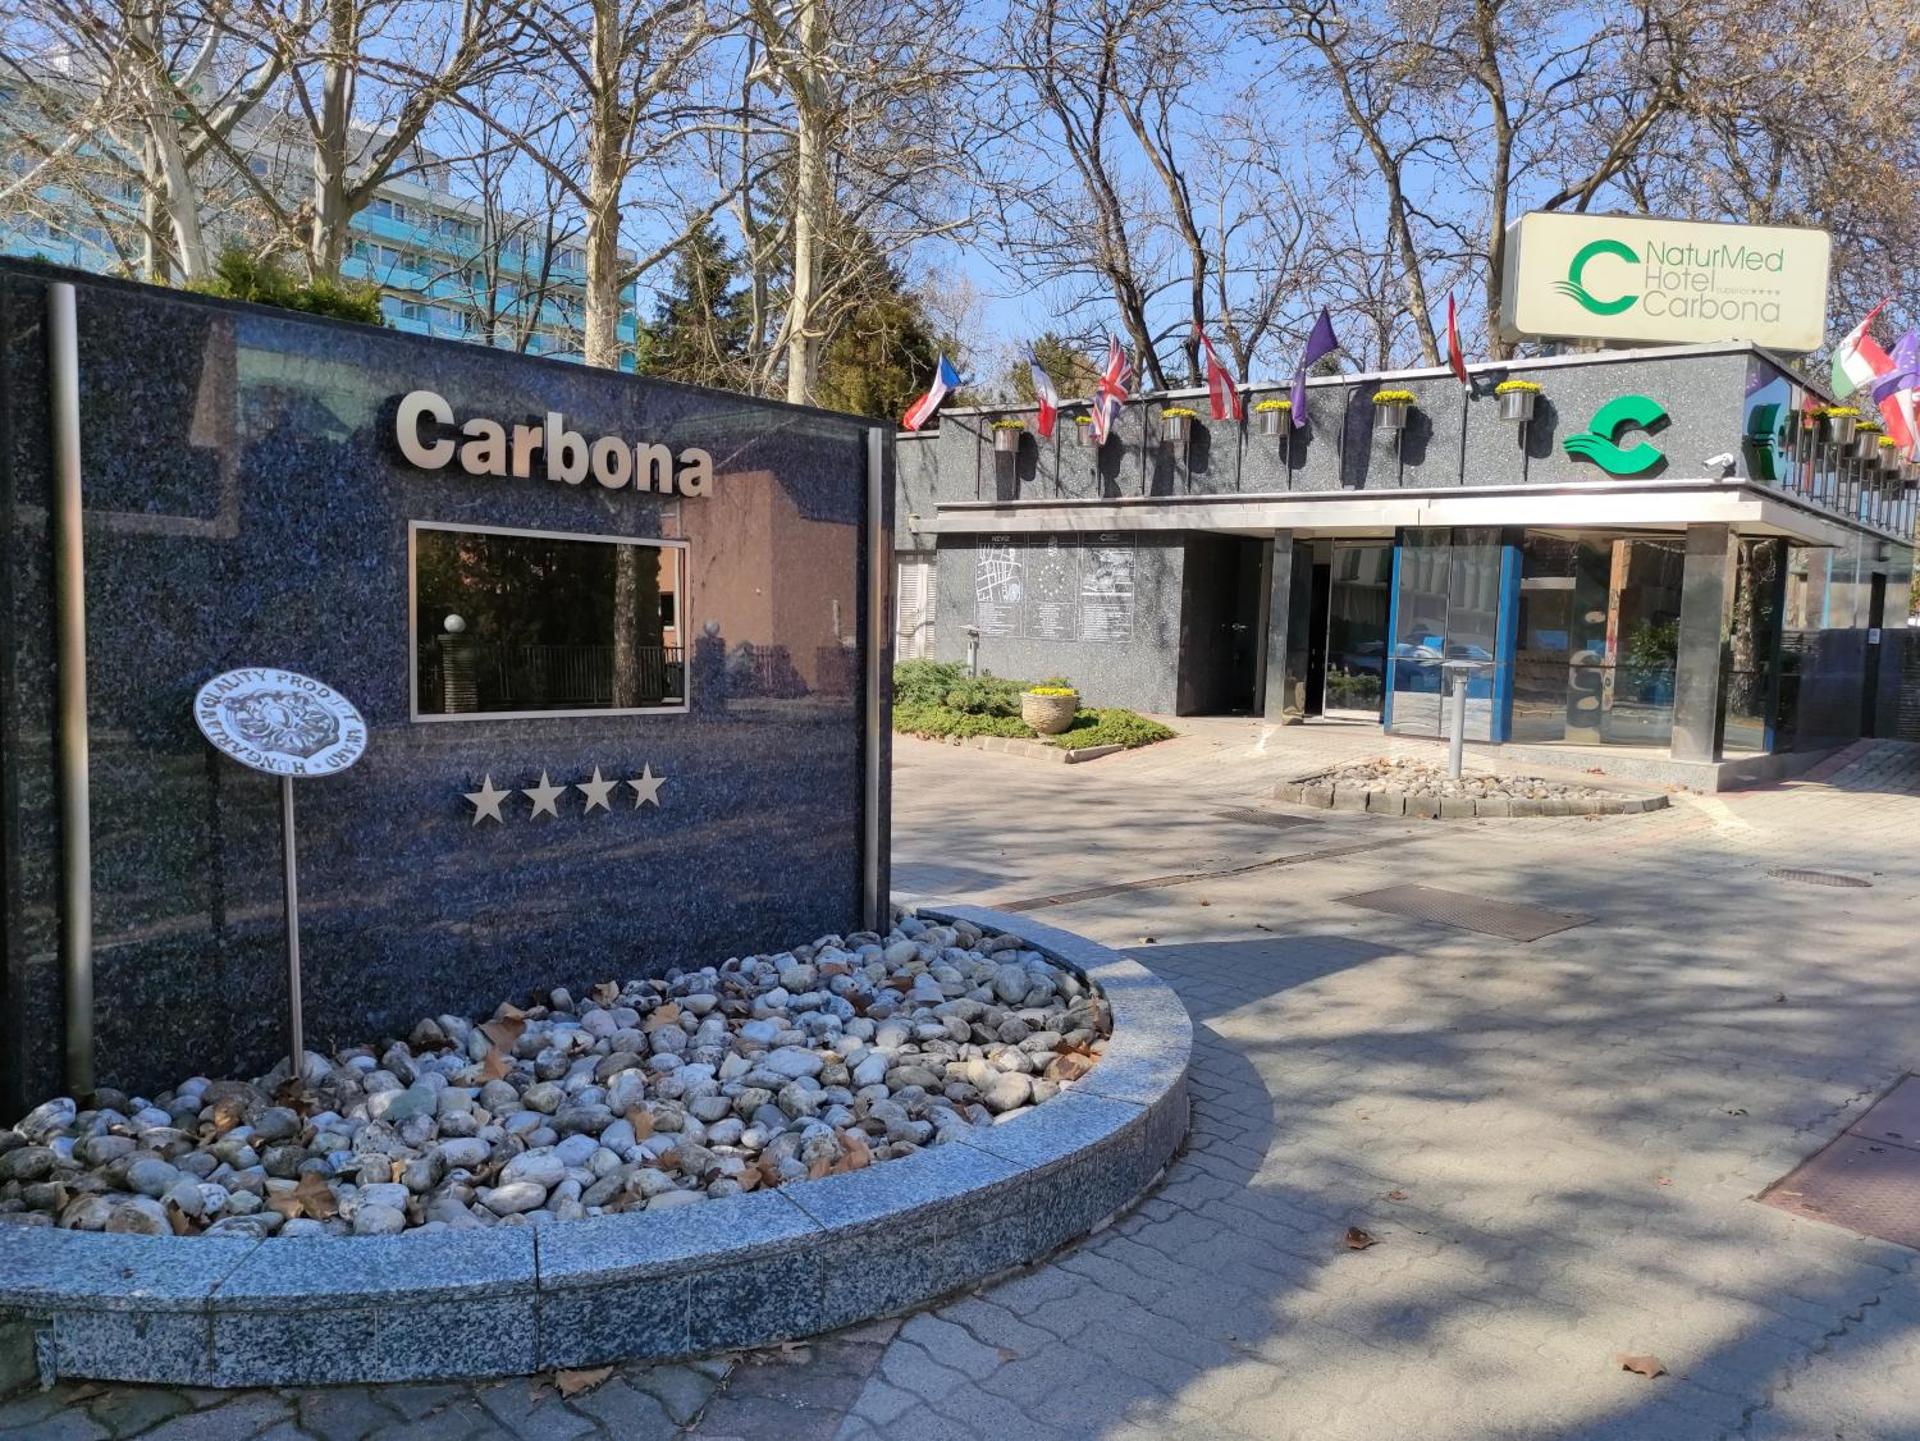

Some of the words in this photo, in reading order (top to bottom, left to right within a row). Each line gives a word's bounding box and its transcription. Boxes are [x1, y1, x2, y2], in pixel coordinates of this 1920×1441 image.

[1646, 240, 1785, 273] NaturMed
[1645, 264, 1716, 293] Hotel
[1642, 289, 1781, 323] Carbona
[396, 389, 714, 498] Carbona
[200, 670, 268, 709] QUALITY
